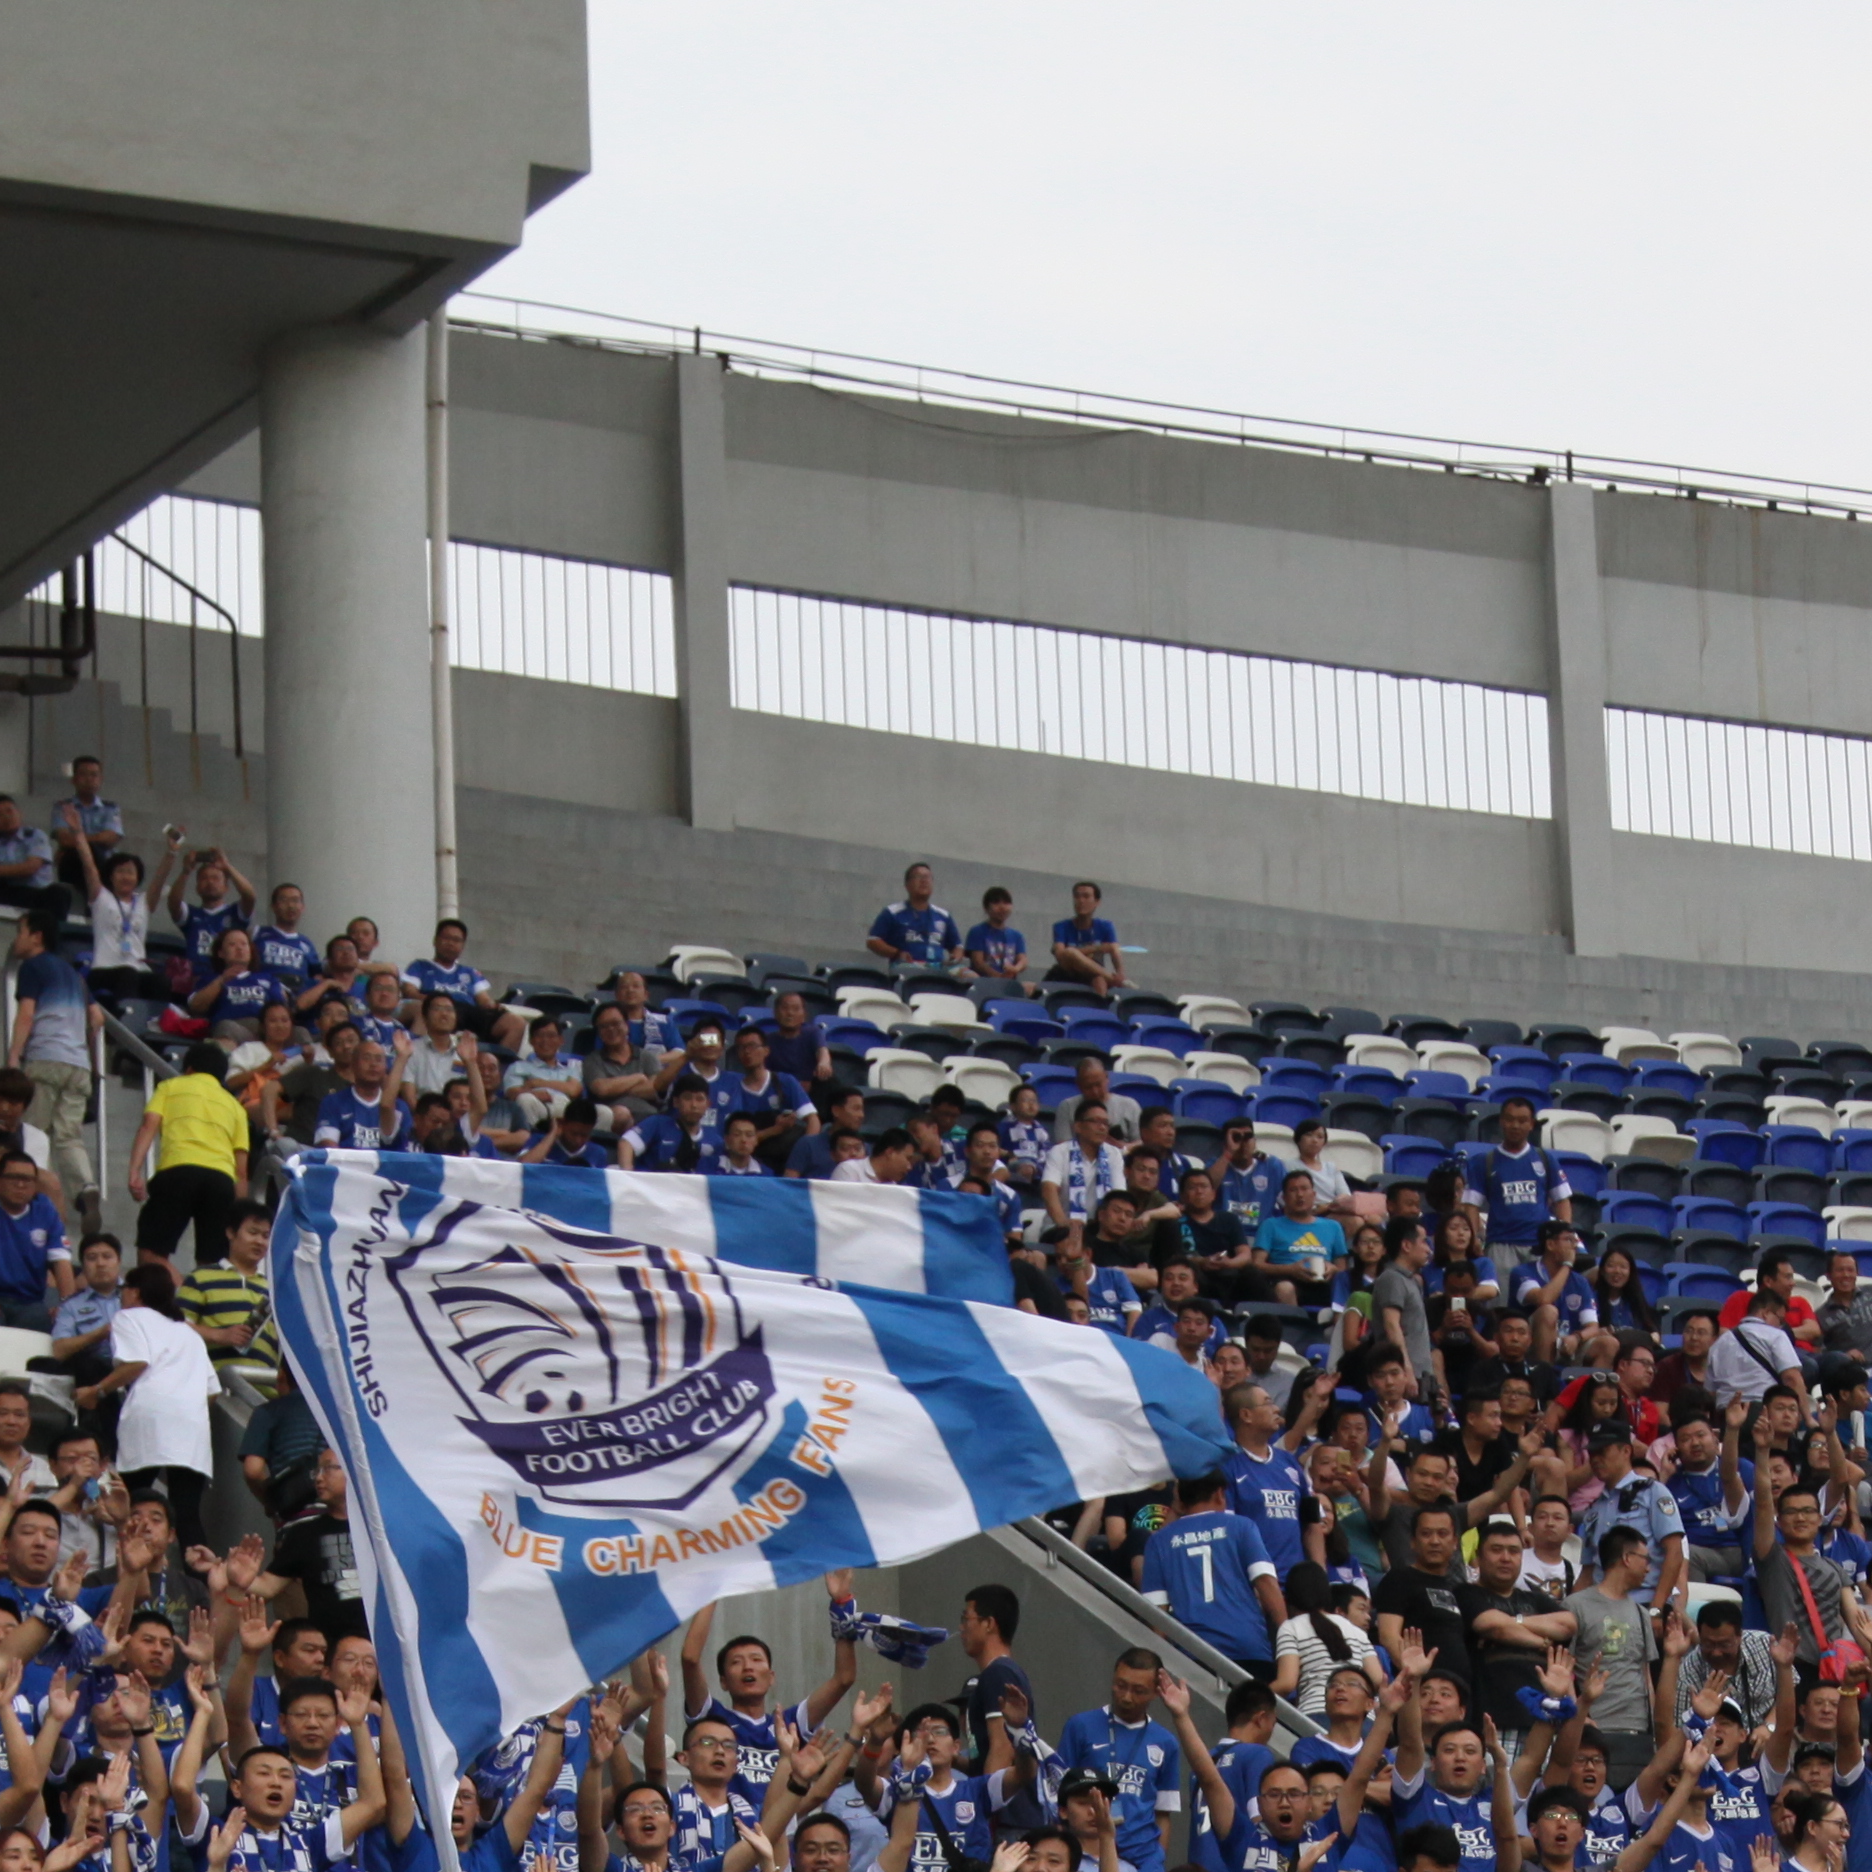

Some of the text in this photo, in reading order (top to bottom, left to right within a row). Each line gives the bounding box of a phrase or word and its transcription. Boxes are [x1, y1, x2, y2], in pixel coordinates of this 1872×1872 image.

[264, 940, 304, 961] EBG
[227, 985, 265, 1000] EBG
[1501, 1182, 1536, 1198] EBG
[542, 1370, 724, 1447] EVER BRIGHT
[524, 1379, 761, 1474] FOOTBALL CLUB
[478, 1376, 857, 1574] BLUE CHARMING FANS
[1265, 1491, 1297, 1507] EBG
[1188, 1545, 1213, 1602] 7
[522, 1846, 578, 1866] EBG
